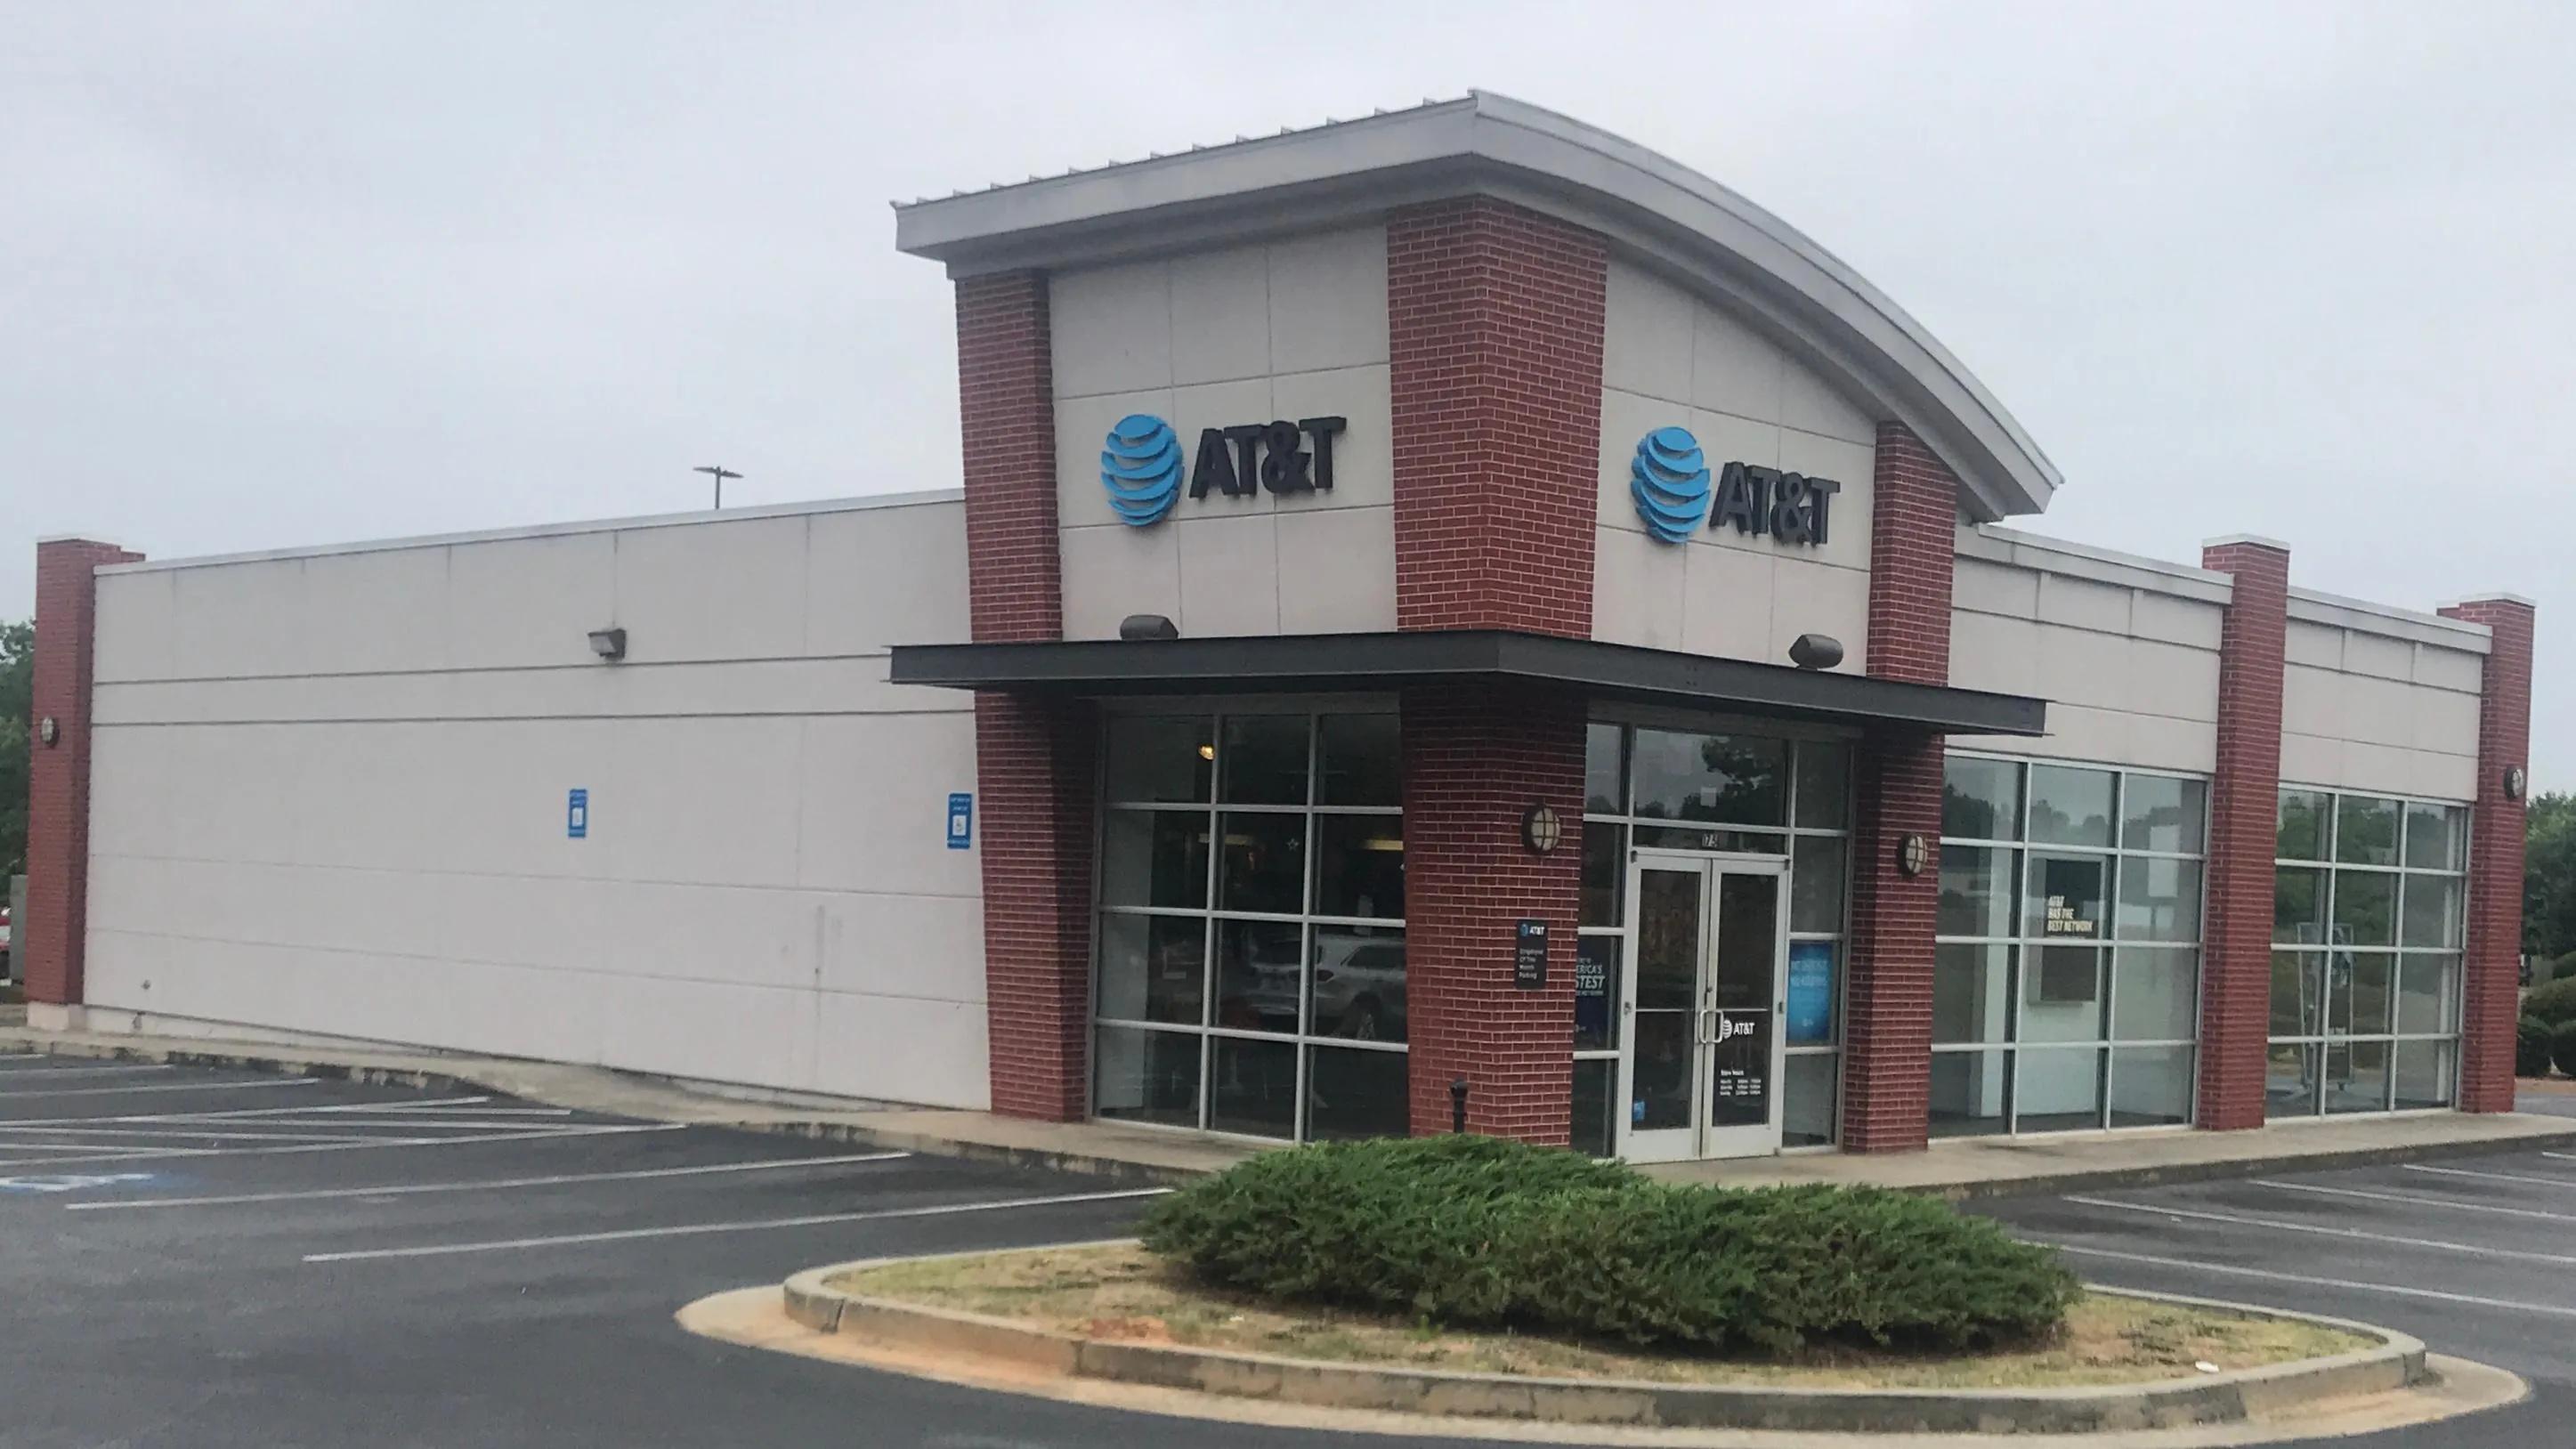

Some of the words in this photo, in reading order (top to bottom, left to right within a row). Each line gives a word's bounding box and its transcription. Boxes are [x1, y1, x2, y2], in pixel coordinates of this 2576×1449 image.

[1189, 416, 1347, 498] AT&T
[1709, 461, 1841, 548] AT&T
[2062, 908, 2074, 919] THE
[1529, 926, 1545, 935] AT&T
[2047, 919, 2063, 932] BEST
[2063, 920, 2094, 933] NETWORK
[1576, 965, 1603, 974] ERICA'S
[1733, 1022, 1755, 1035] AT&T
